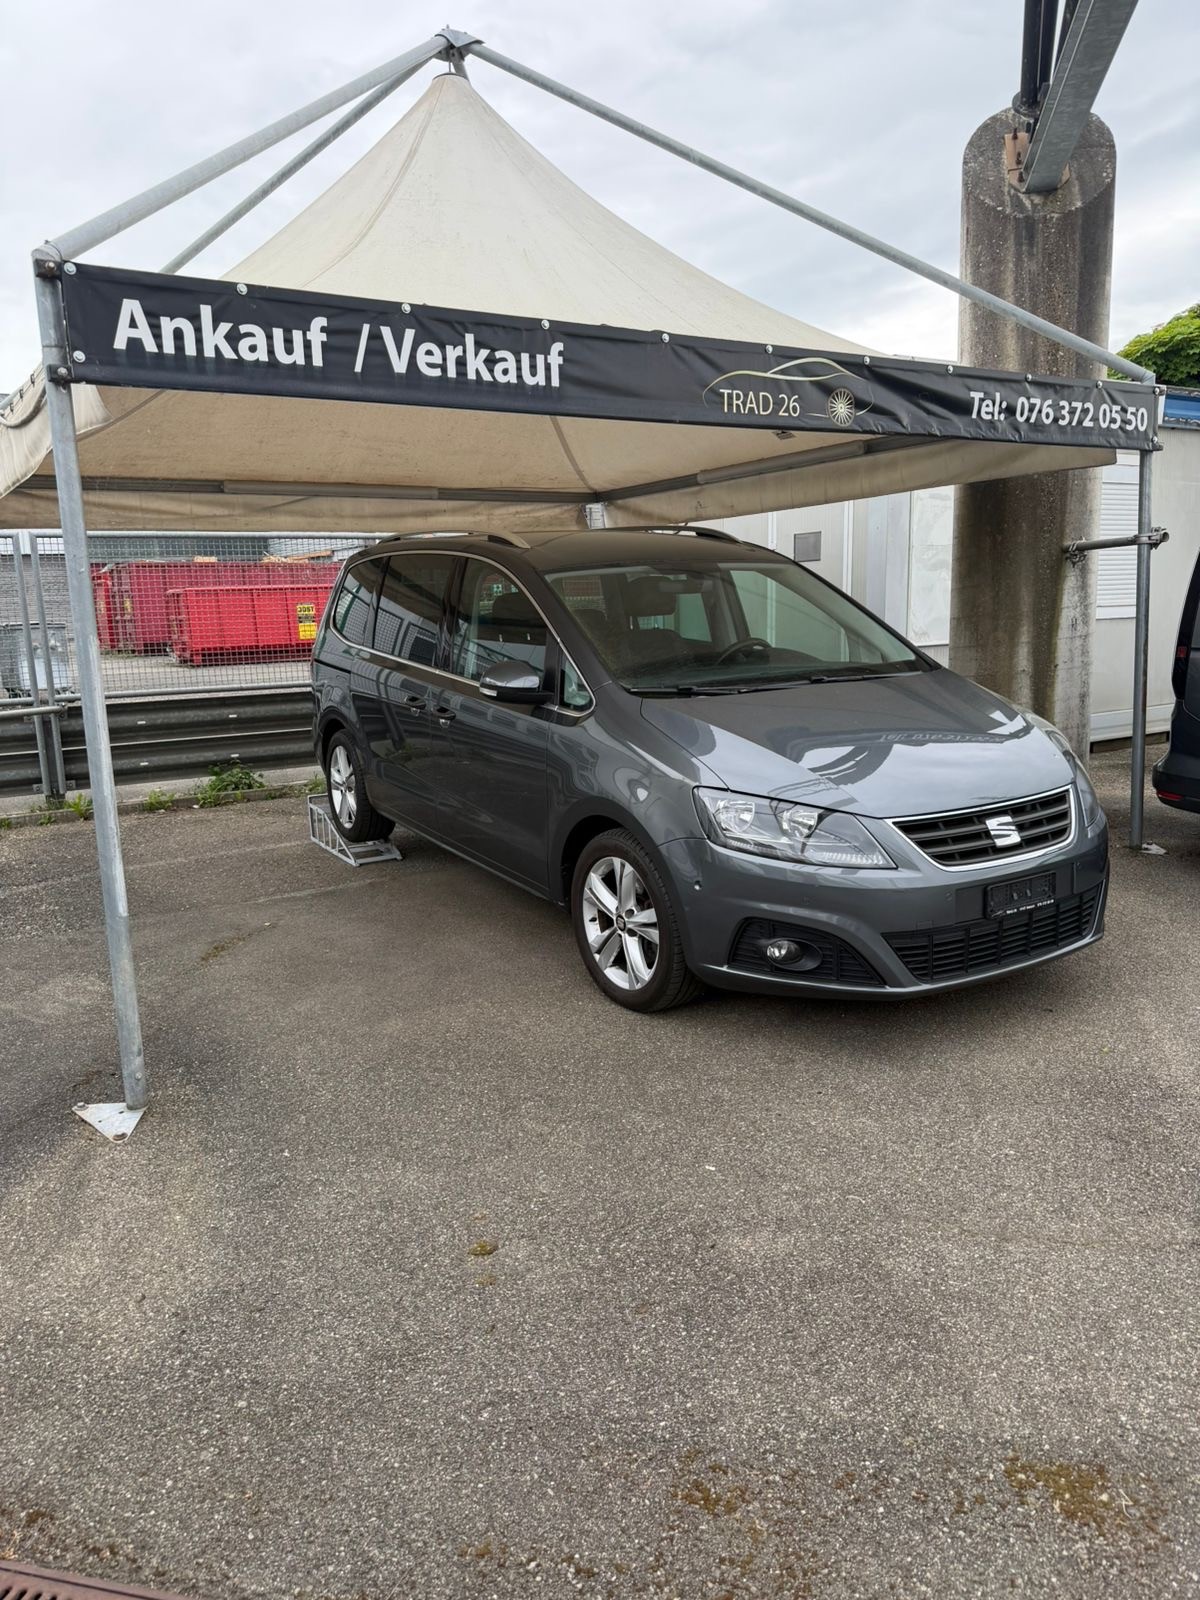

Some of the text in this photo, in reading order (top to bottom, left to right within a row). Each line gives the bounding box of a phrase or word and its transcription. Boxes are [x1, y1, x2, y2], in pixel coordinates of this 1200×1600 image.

[113, 298, 328, 367] Ankauf
[719, 389, 800, 417] TRAD 26
[969, 391, 1148, 432] Tel: 076 372 05 50
